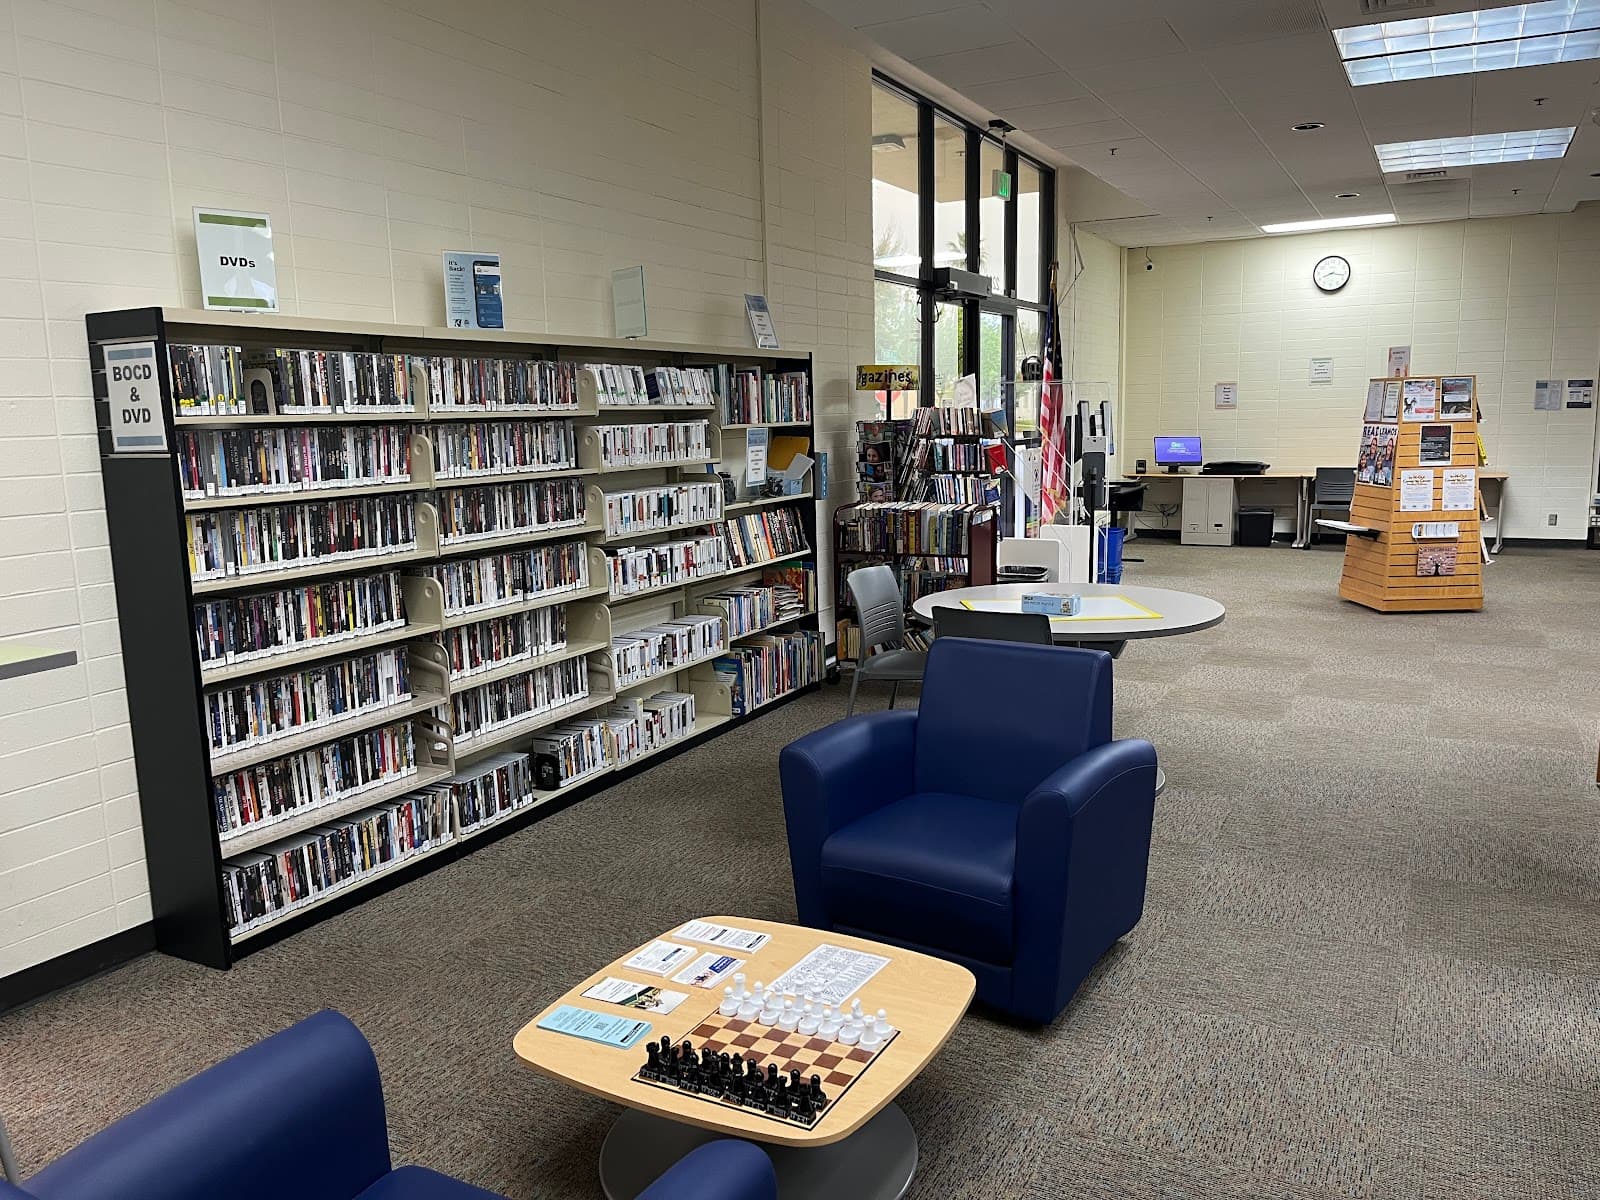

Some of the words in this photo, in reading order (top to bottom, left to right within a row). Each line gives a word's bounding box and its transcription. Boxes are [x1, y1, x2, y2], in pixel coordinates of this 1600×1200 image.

[219, 255, 256, 268] DVDs
[112, 364, 152, 382] BOCD
[130, 386, 141, 402] &
[122, 408, 152, 424] DVD
